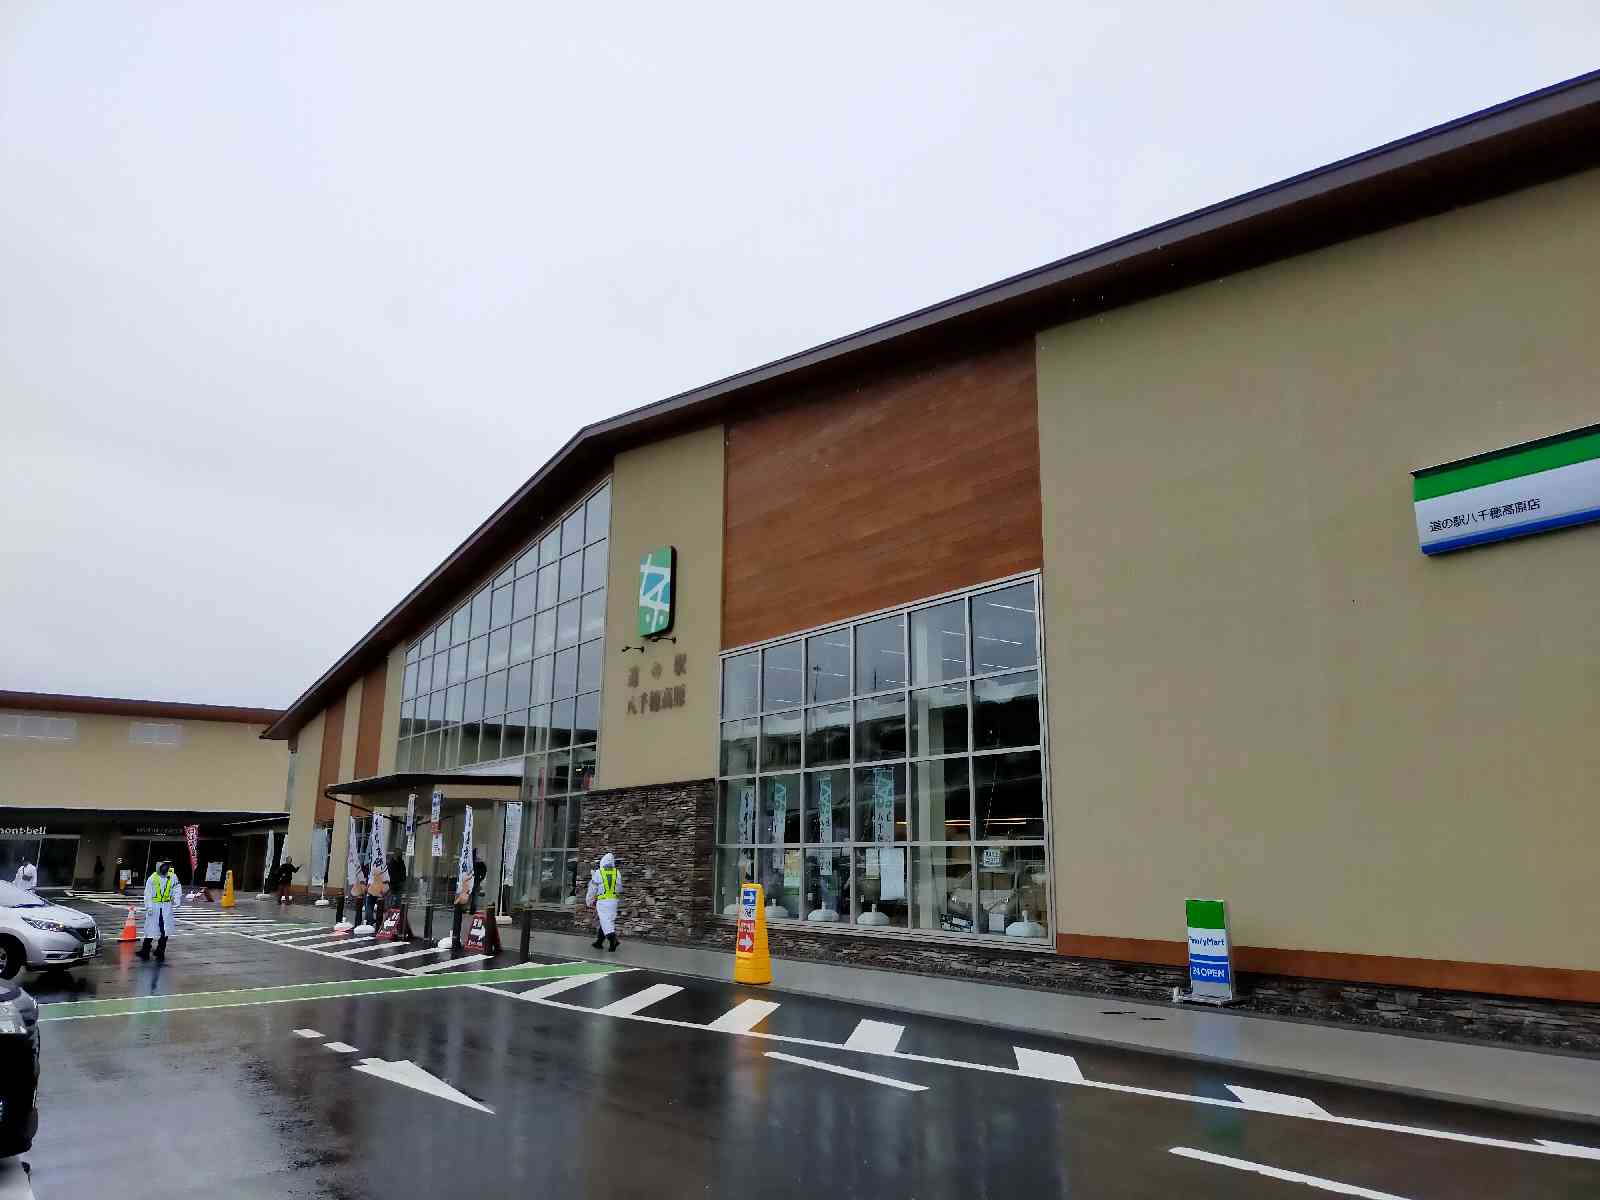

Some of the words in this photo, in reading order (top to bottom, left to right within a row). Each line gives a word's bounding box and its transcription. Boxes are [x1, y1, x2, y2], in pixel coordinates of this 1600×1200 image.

[1430, 498, 1541, 532] 道の駅八千穂高原店
